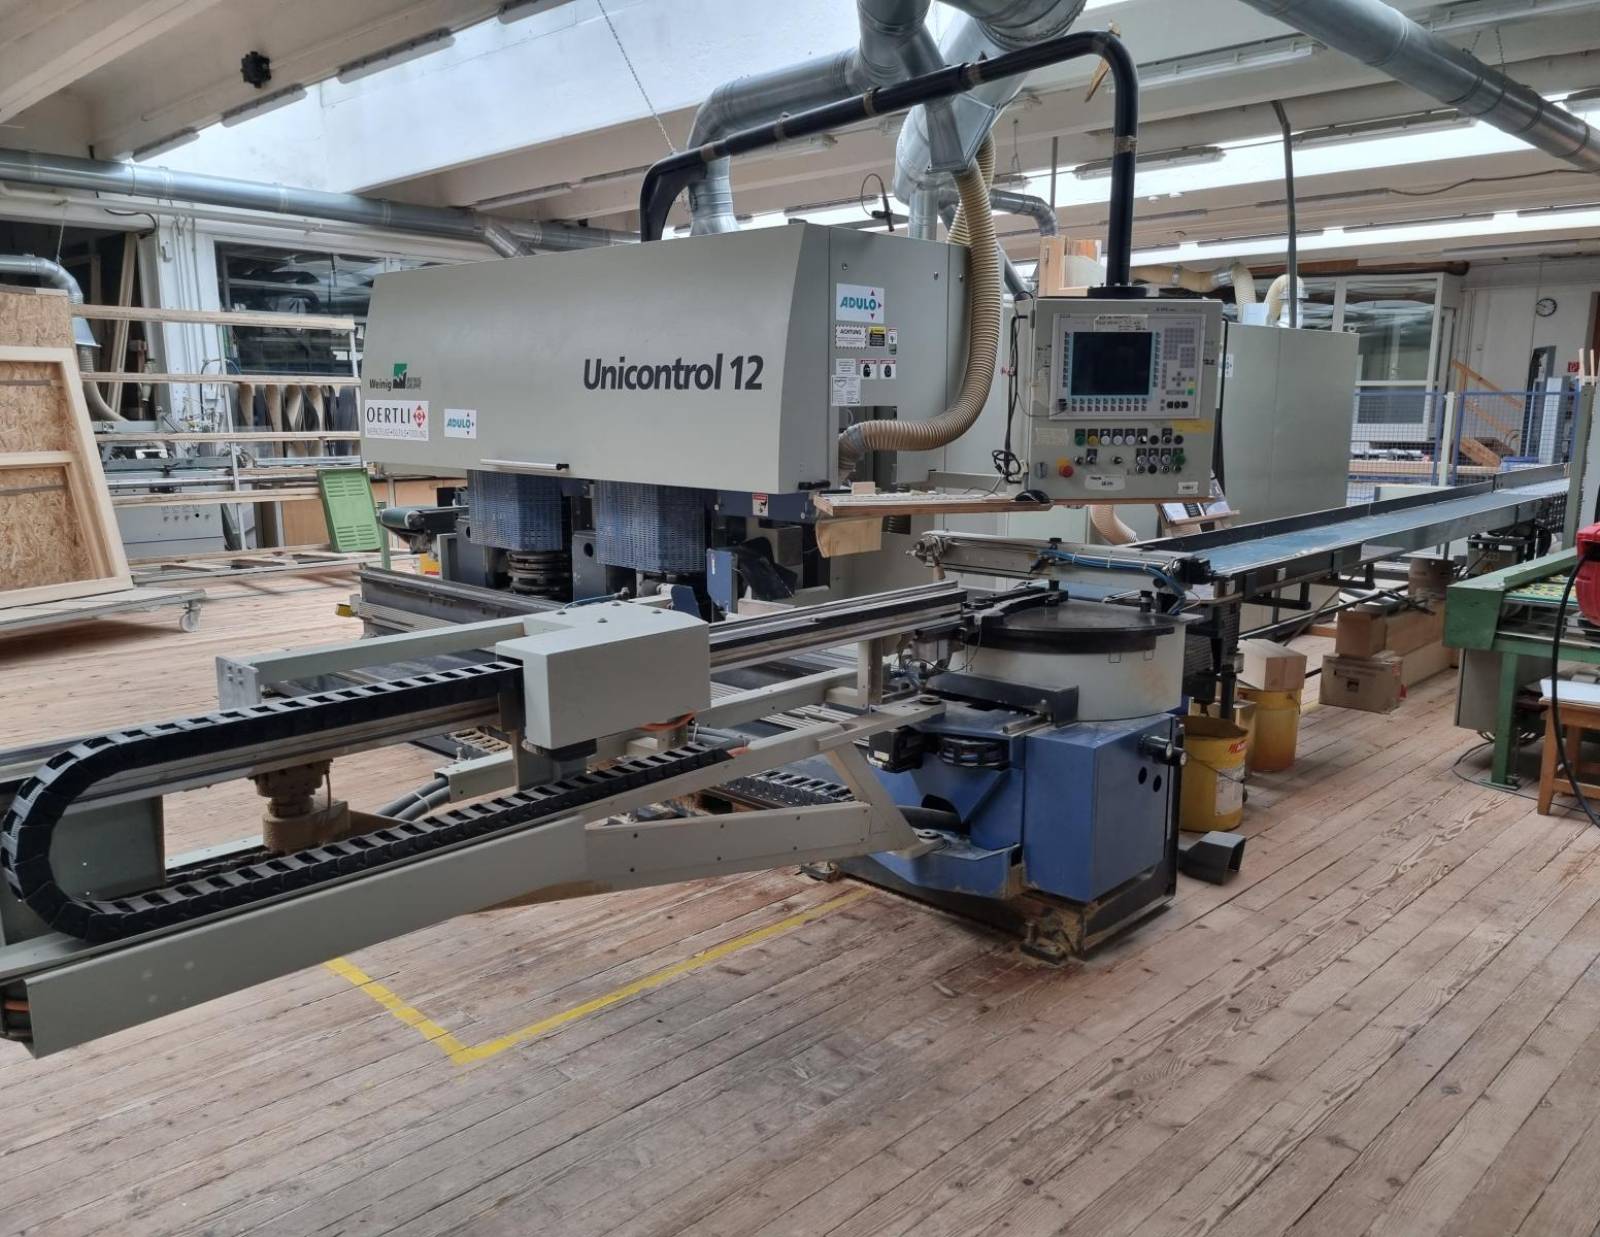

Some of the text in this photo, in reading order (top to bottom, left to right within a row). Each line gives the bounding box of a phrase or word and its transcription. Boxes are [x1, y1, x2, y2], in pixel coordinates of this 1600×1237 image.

[840, 297, 877, 311] ADULO
[584, 353, 764, 390] Unicontrol 12
[369, 378, 392, 391] Weinig
[366, 406, 411, 424] OERTLI
[446, 418, 471, 429] ADULO
